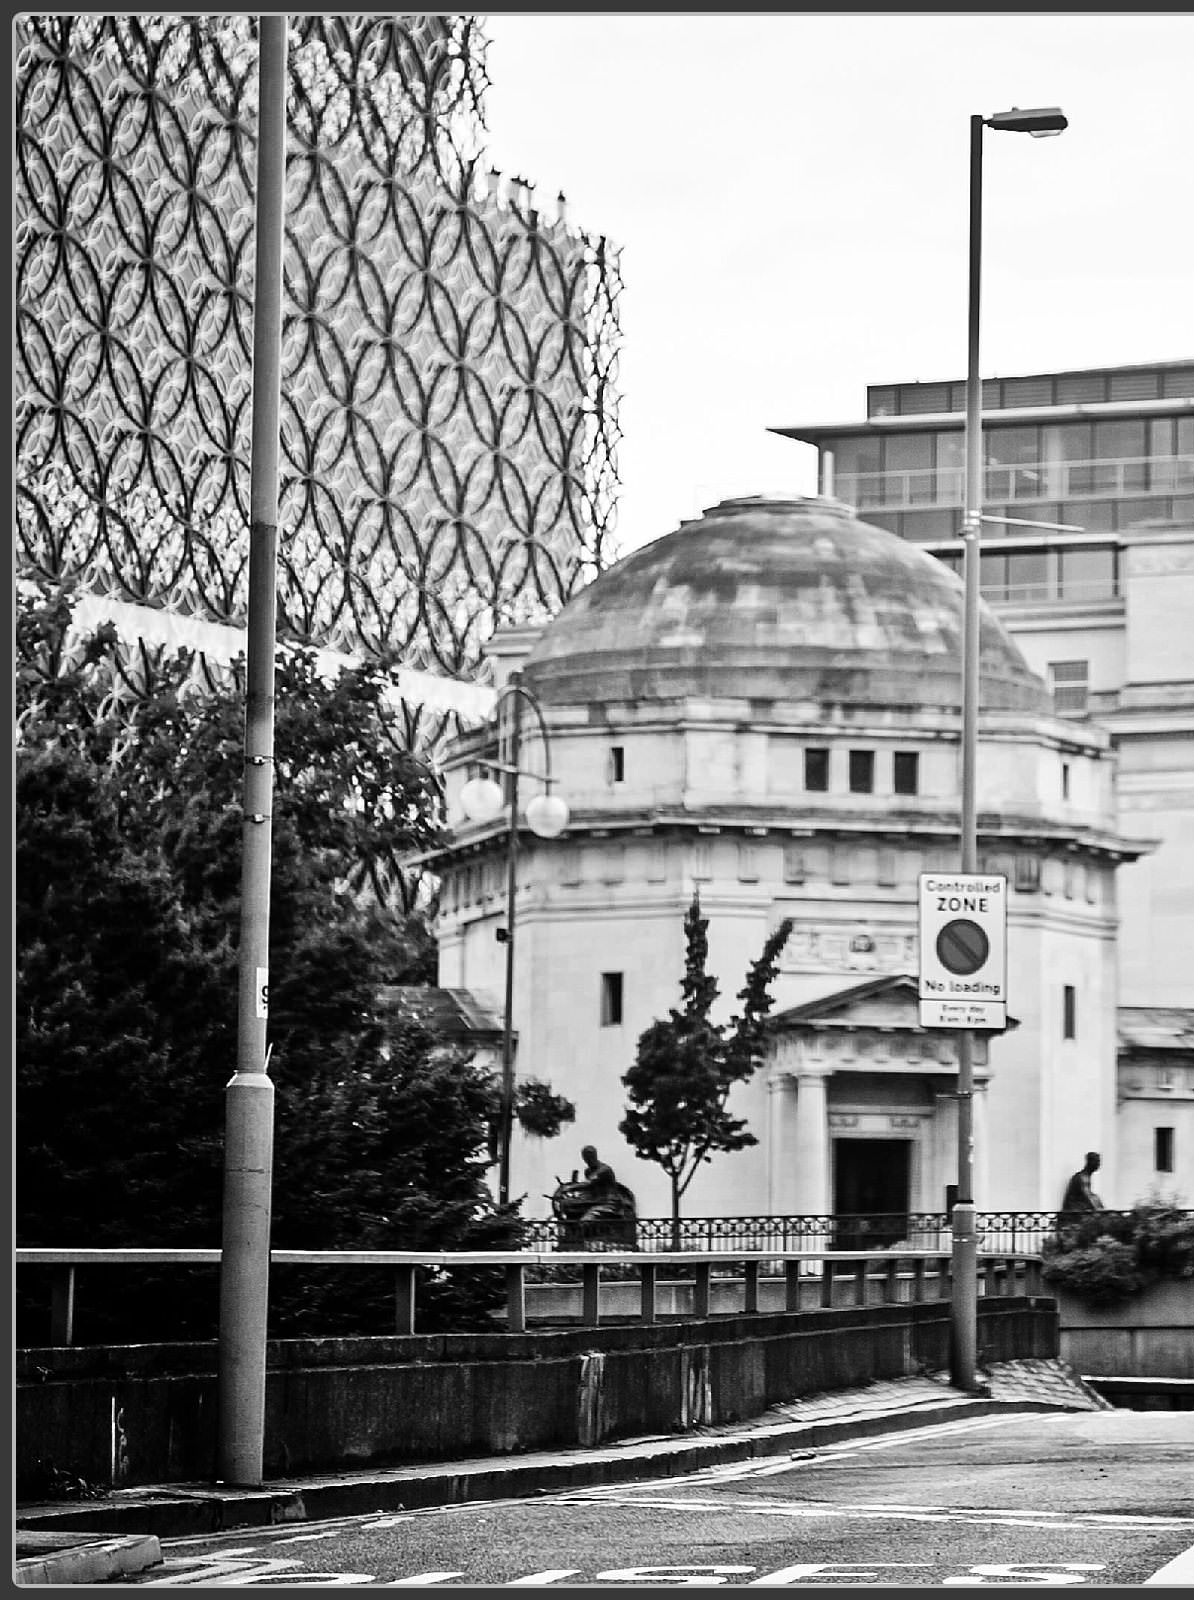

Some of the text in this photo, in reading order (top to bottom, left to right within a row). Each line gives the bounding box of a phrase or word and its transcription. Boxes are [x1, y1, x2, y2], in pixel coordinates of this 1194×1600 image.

[926, 880, 1001, 893] Controlled
[937, 898, 989, 912] ZONE
[925, 980, 1000, 995] No loading
